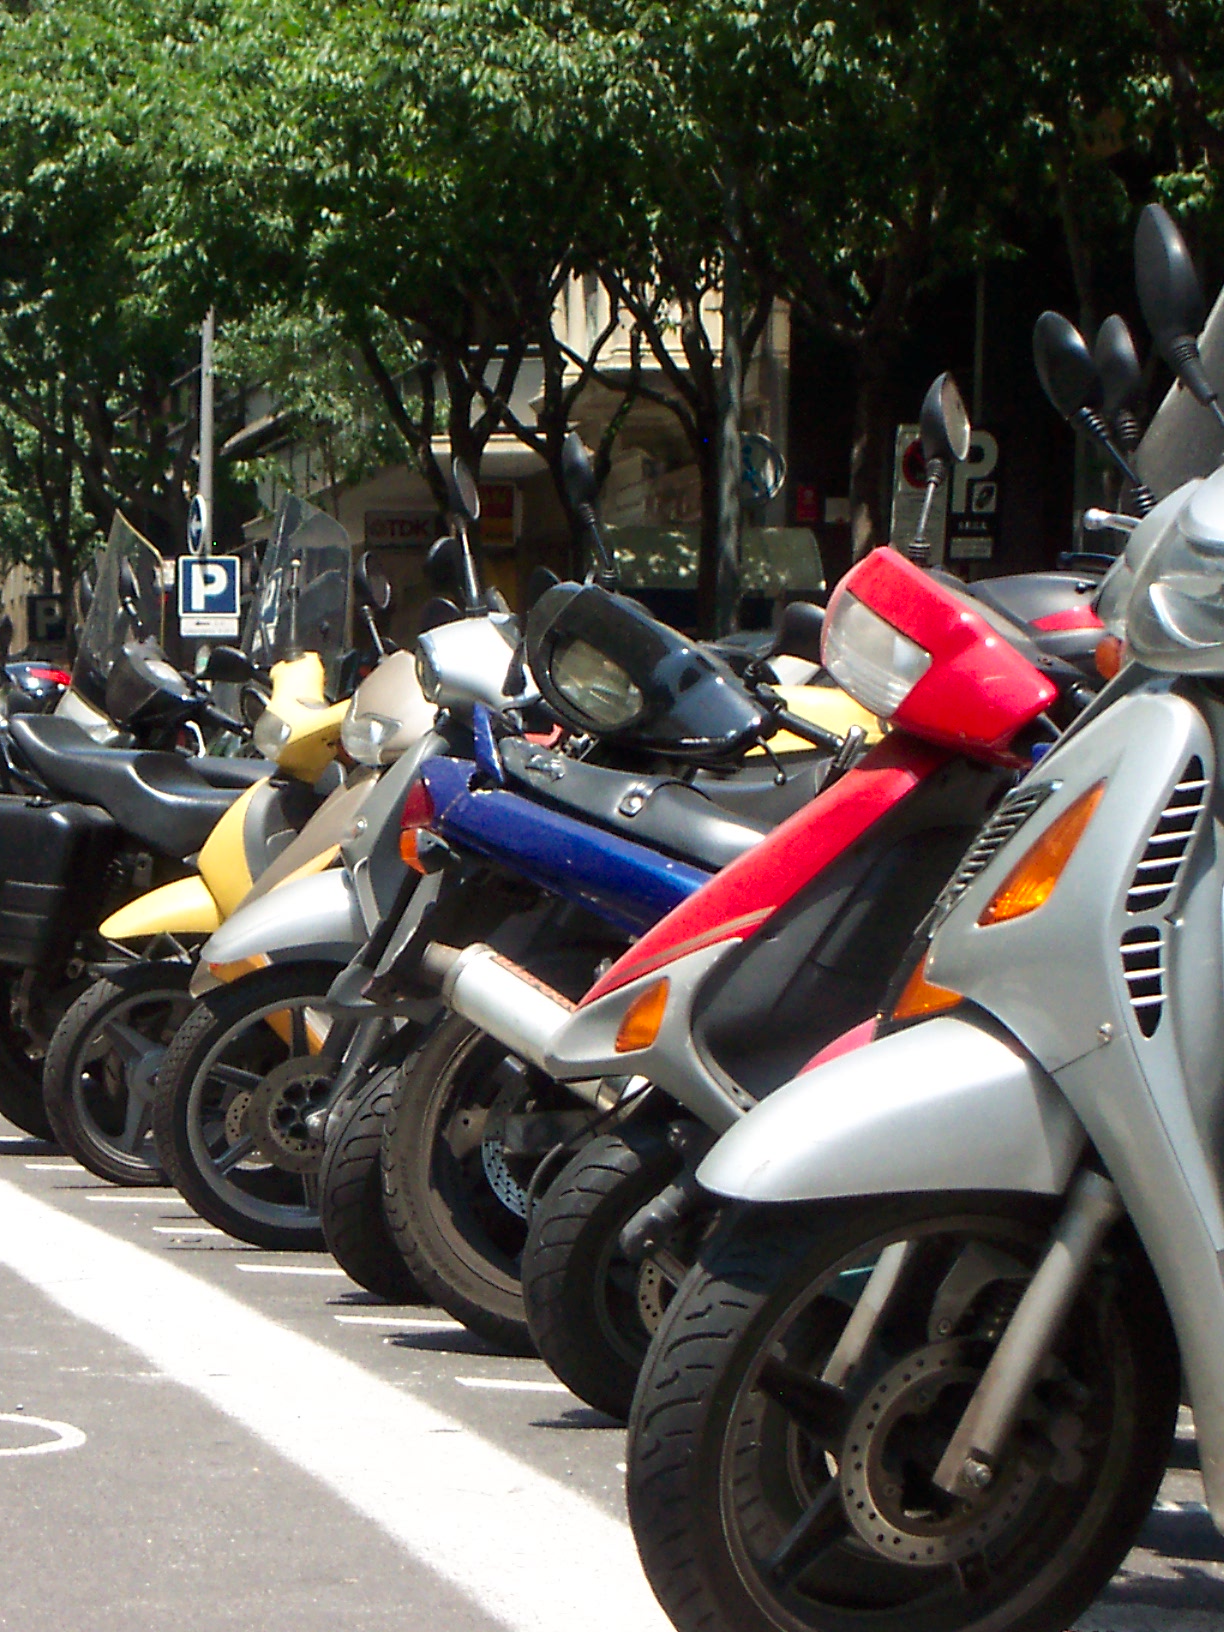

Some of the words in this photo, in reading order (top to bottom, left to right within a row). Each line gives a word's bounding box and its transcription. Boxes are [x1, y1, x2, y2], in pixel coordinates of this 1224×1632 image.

[952, 430, 999, 513] P
[386, 519, 429, 537] TDK
[190, 563, 228, 611] P
[36, 599, 61, 637] P
